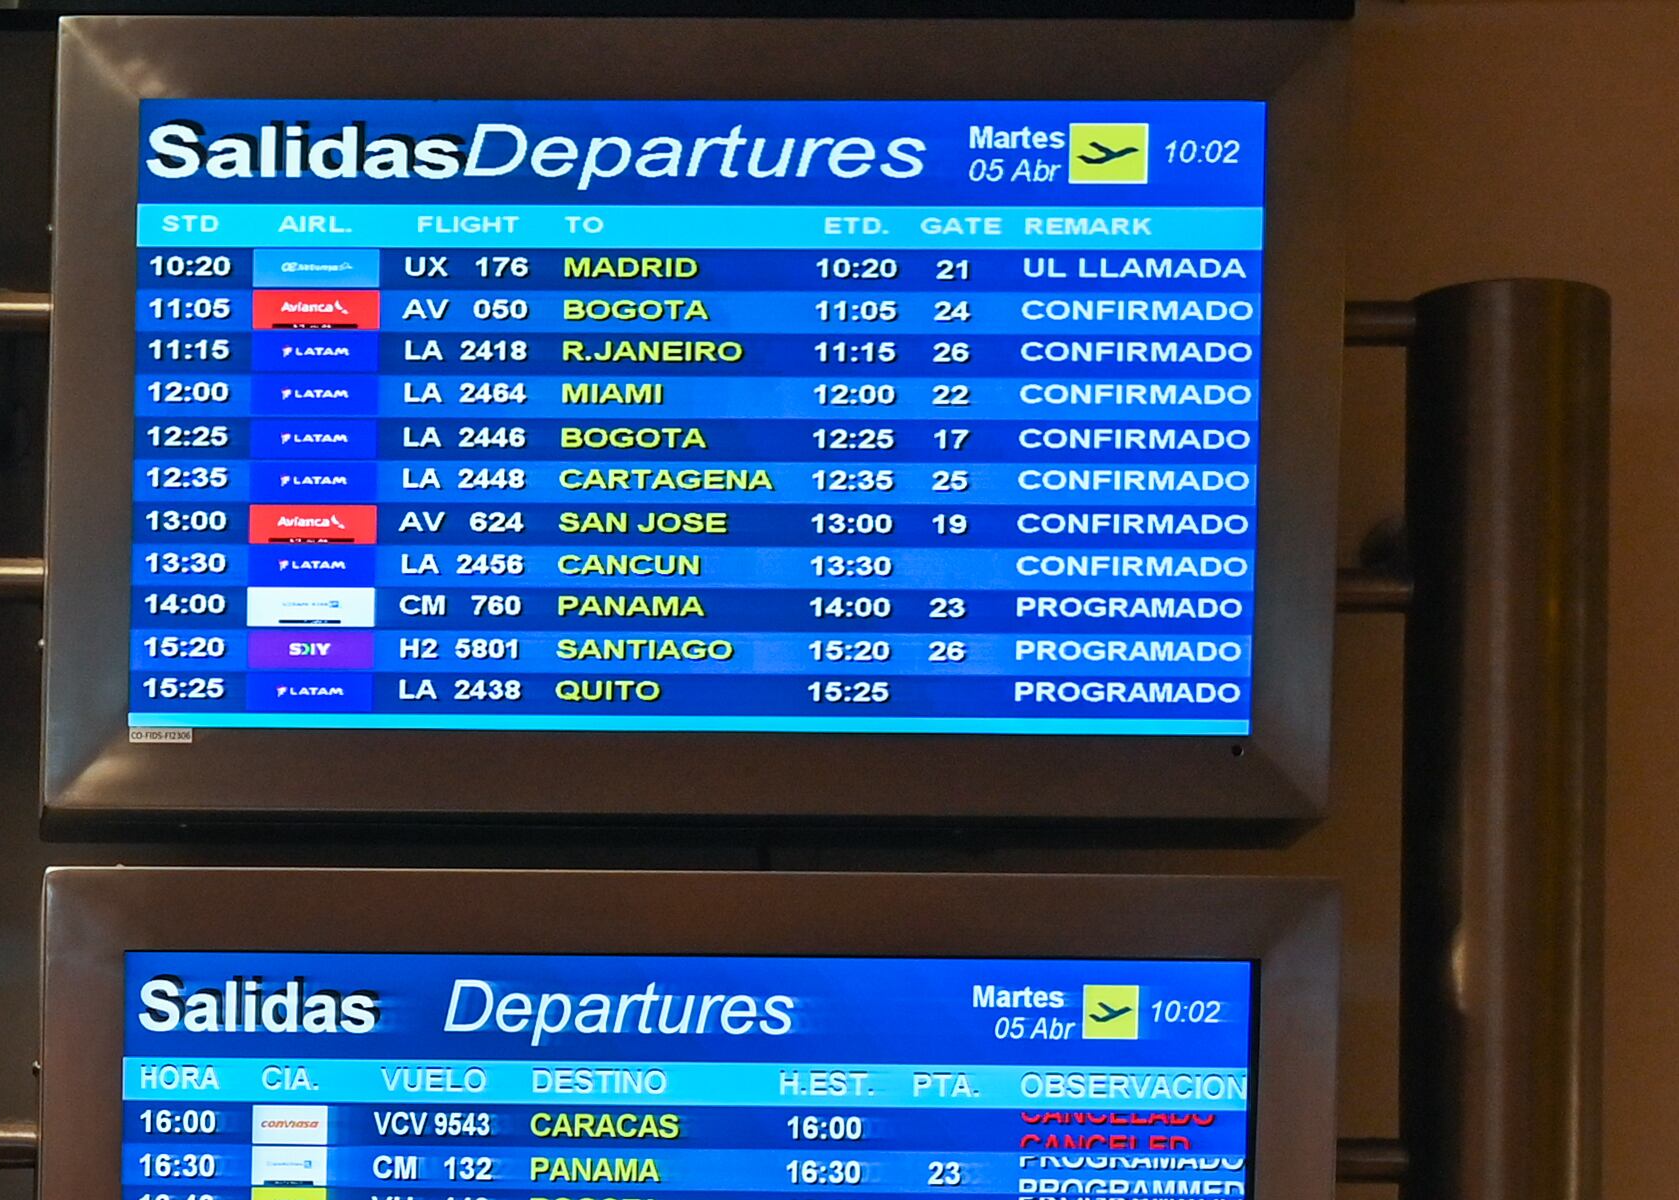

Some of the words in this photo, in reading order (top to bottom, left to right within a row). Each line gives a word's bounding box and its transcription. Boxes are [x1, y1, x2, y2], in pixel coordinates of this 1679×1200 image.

[970, 126, 1064, 149] Martes
[1166, 140, 1240, 163] 10:02
[969, 159, 1003, 181] 05
[1011, 159, 1061, 181] Abr
[163, 215, 219, 232] STD
[278, 216, 352, 233] AIRL.
[418, 216, 519, 233] FLIGHT
[565, 216, 604, 233] TO
[825, 217, 888, 234] ETD.
[921, 217, 1002, 235] GATE
[1025, 218, 1151, 235] REMARK
[150, 256, 230, 276] 10:20
[406, 257, 447, 276] UX
[476, 257, 528, 276] 176
[565, 257, 697, 277] MADRID
[817, 258, 897, 278] 10:20
[936, 260, 967, 279] 21
[1024, 258, 1066, 277] UL
[1079, 258, 1246, 278] LLAMADA
[150, 298, 229, 318] 11:05
[281, 300, 333, 313] Avianca
[402, 299, 448, 319] AV
[474, 299, 527, 319] 050
[564, 300, 707, 319] BOGOTA
[816, 301, 896, 320] 11:05
[934, 301, 970, 320] 24
[1022, 300, 1253, 320] CONFIRMADO
[143, 678, 223, 697] 15:25
[290, 687, 343, 695] LATAM
[400, 679, 437, 699] LA
[454, 680, 520, 699] 2438
[556, 681, 659, 700] QUITO
[808, 682, 888, 701] 15:25
[1015, 682, 1240, 703] PROGRAMADO
[973, 985, 1064, 1008] Martes
[1152, 1000, 1220, 1023] 10:02
[995, 1017, 1025, 1039] 05
[1030, 1017, 1076, 1040] Abr
[141, 1066, 219, 1089] HORA
[262, 1067, 319, 1090] CIA.
[381, 1069, 487, 1092] VUELO
[533, 1070, 667, 1094] DESTINO
[781, 1073, 874, 1096] H.EST.
[914, 1074, 980, 1097] PTA.
[1021, 1075, 1246, 1100] OBSERVACION
[141, 1110, 215, 1133] 16:00
[261, 1119, 318, 1129] conviasa
[374, 1112, 427, 1135] VCV
[435, 1113, 489, 1135] 9543
[531, 1113, 678, 1138] CARACAS
[788, 1116, 861, 1139] 16:00
